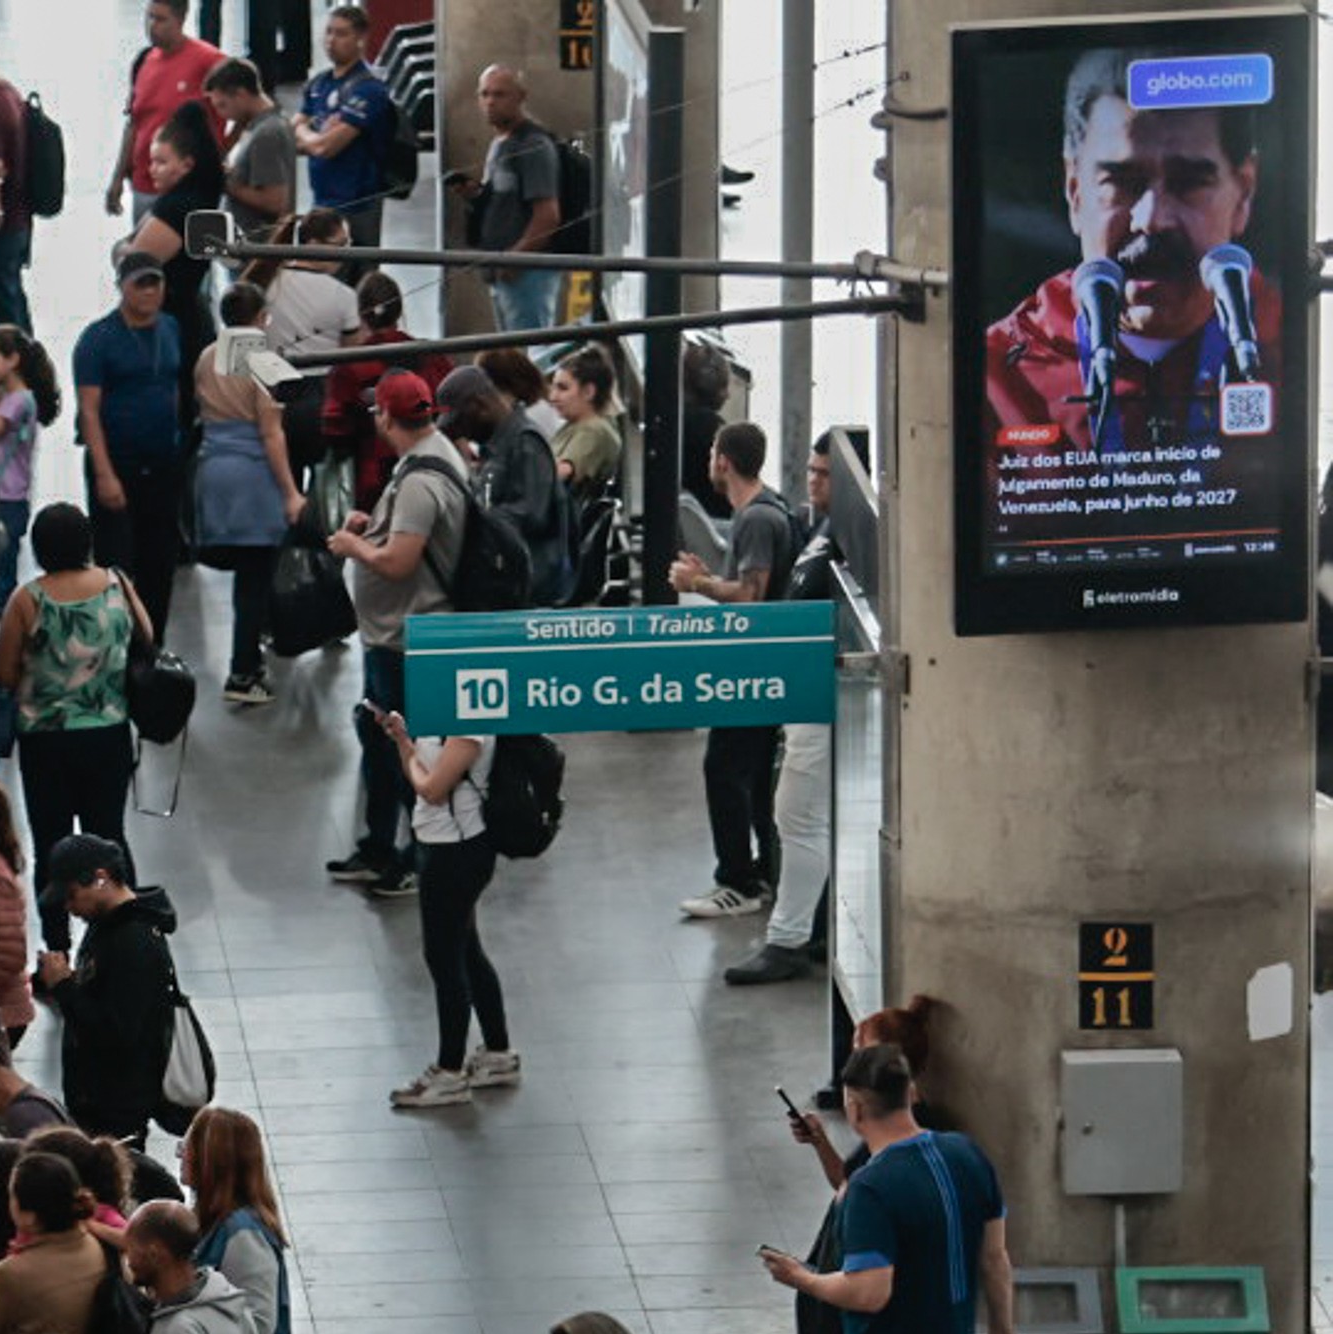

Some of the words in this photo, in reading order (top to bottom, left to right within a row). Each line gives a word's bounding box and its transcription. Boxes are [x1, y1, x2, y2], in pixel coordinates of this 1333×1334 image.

[1147, 71, 1253, 95] globo.com
[998, 452, 1029, 470] Juiz
[1032, 452, 1061, 468] dos
[1065, 450, 1098, 466] EUA
[1100, 450, 1151, 464] marca
[1201, 444, 1222, 460] de
[998, 476, 1085, 497] julgamento
[1088, 474, 1110, 489] de
[1112, 470, 1176, 487] Maduro,
[1179, 468, 1201, 483] da
[999, 498, 1082, 515] Venezuela,
[1085, 496, 1122, 515] para
[1124, 492, 1168, 512] junho
[1171, 490, 1194, 508] de
[1196, 488, 1238, 506] 2027
[526, 617, 617, 640] Sentido
[648, 613, 715, 635] Trains
[722, 612, 750, 633] To
[461, 678, 505, 711] 10
[526, 677, 581, 708] Rio
[593, 676, 629, 706] G.
[641, 674, 683, 704] da
[695, 674, 786, 702] Serra
[1102, 927, 1128, 967] 2
[1093, 986, 1132, 1027] 11
